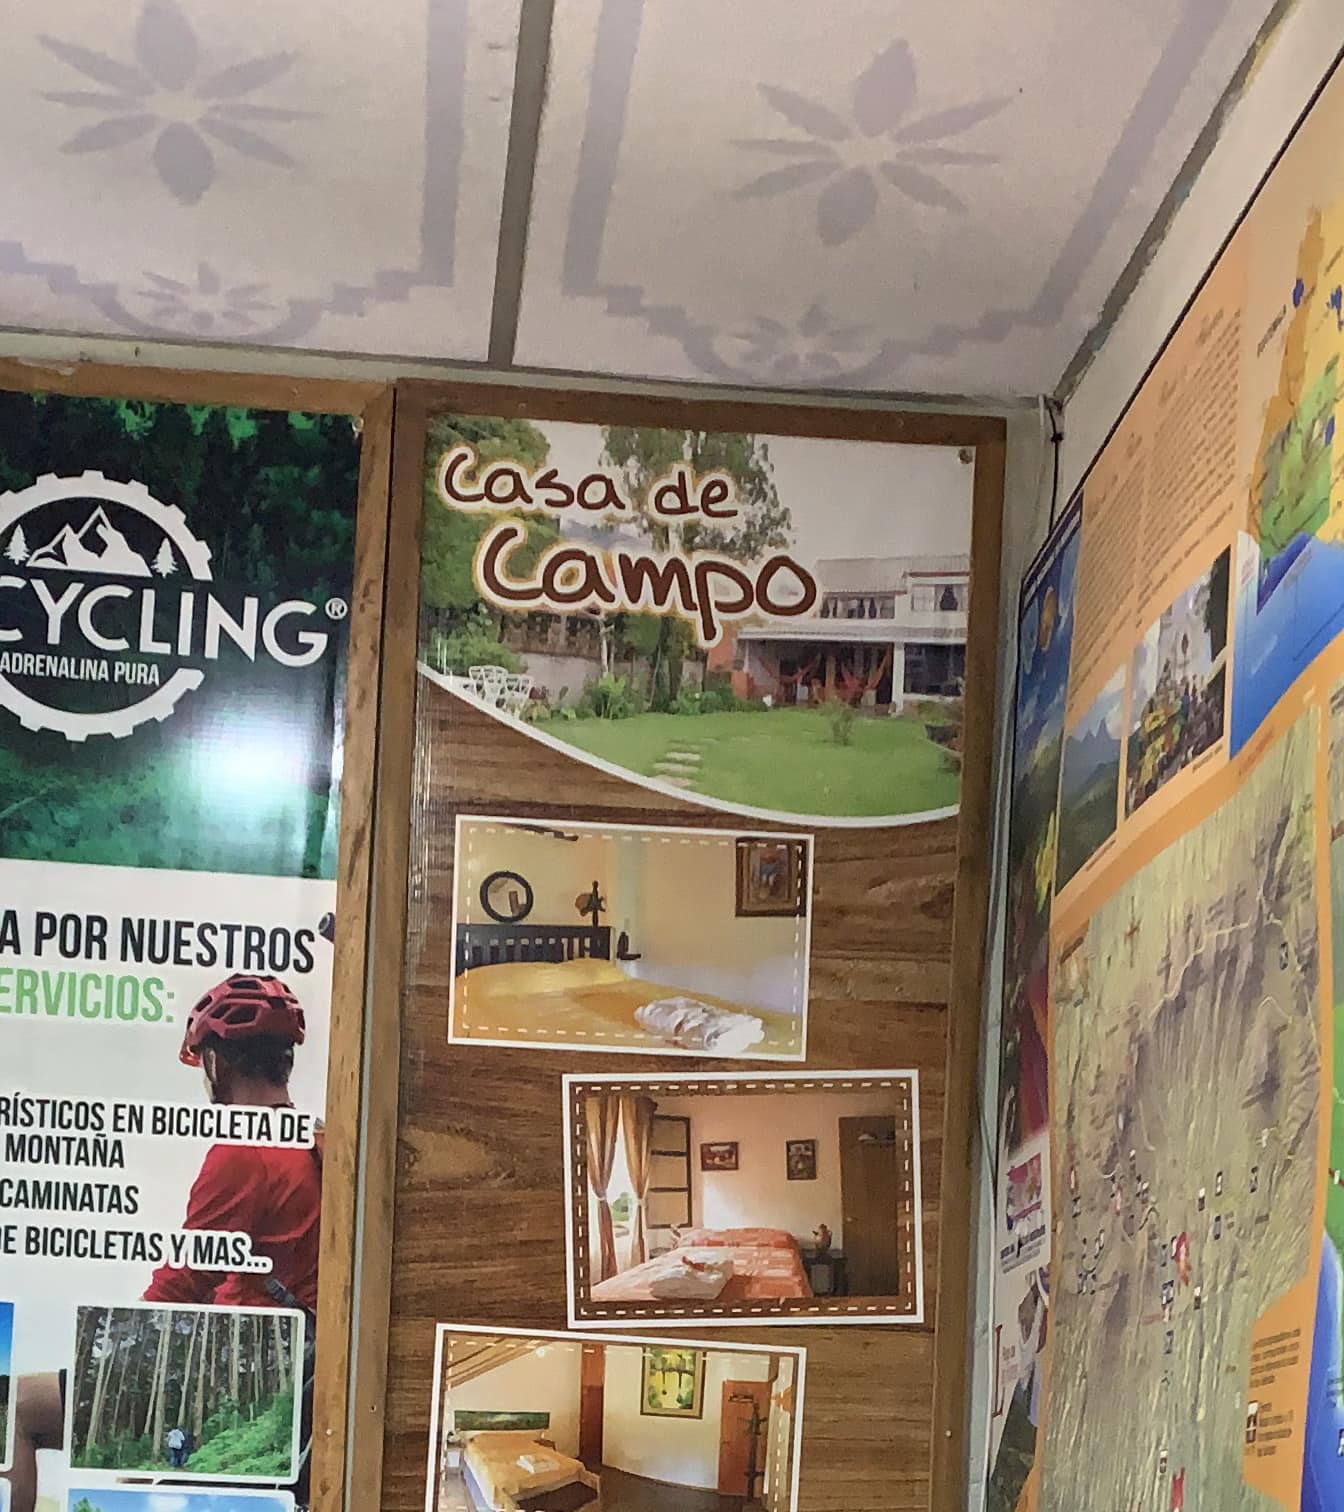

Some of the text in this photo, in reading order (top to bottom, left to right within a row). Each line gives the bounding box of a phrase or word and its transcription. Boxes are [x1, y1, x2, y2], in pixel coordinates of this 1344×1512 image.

[444, 452, 739, 519] Casa de
[483, 527, 818, 641] Campo
[0, 650, 160, 686] ADRENALINA PURA
[33, 911, 108, 962] POR
[119, 917, 315, 974] NUESTROS
[112, 1098, 144, 1134] EN
[151, 1101, 273, 1142] BICICLETA
[279, 1113, 311, 1144] DE
[4, 1131, 125, 1169] MONTAÑA
[24, 1227, 164, 1263] BICICLETAS
[166, 1235, 187, 1264] Y
